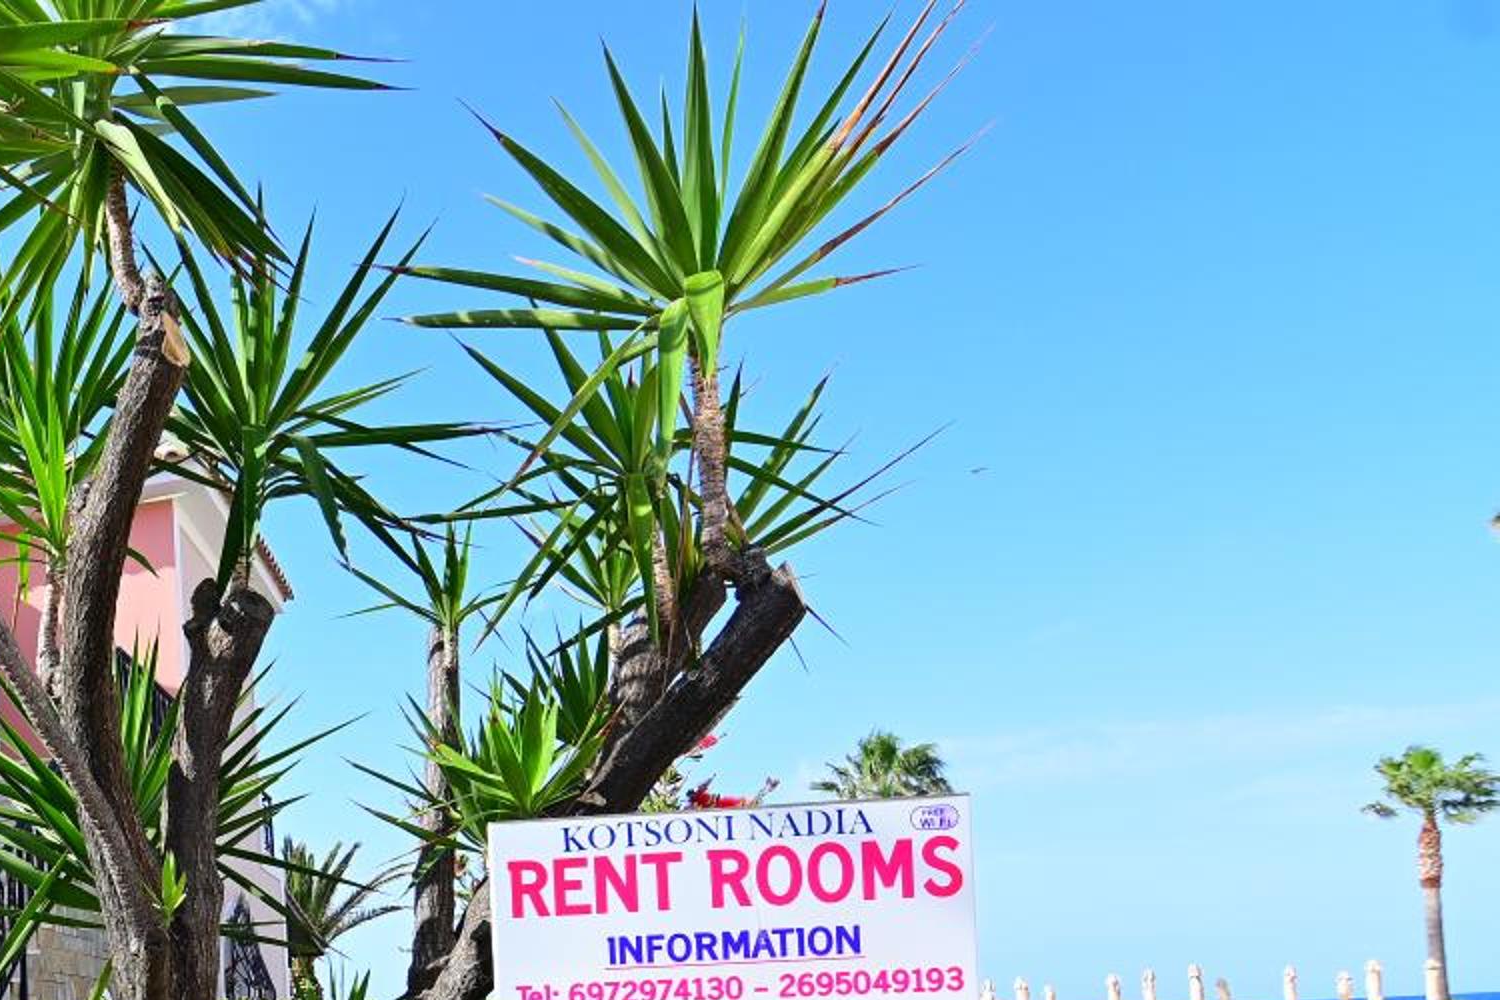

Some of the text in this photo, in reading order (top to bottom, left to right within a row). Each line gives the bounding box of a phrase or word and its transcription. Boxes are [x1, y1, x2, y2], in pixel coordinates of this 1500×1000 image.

[561, 808, 873, 853] KOTSONI NADIA
[507, 835, 964, 919] RENT ROOMS
[606, 924, 862, 966] INFORMATION
[778, 965, 965, 999] 2695049193
